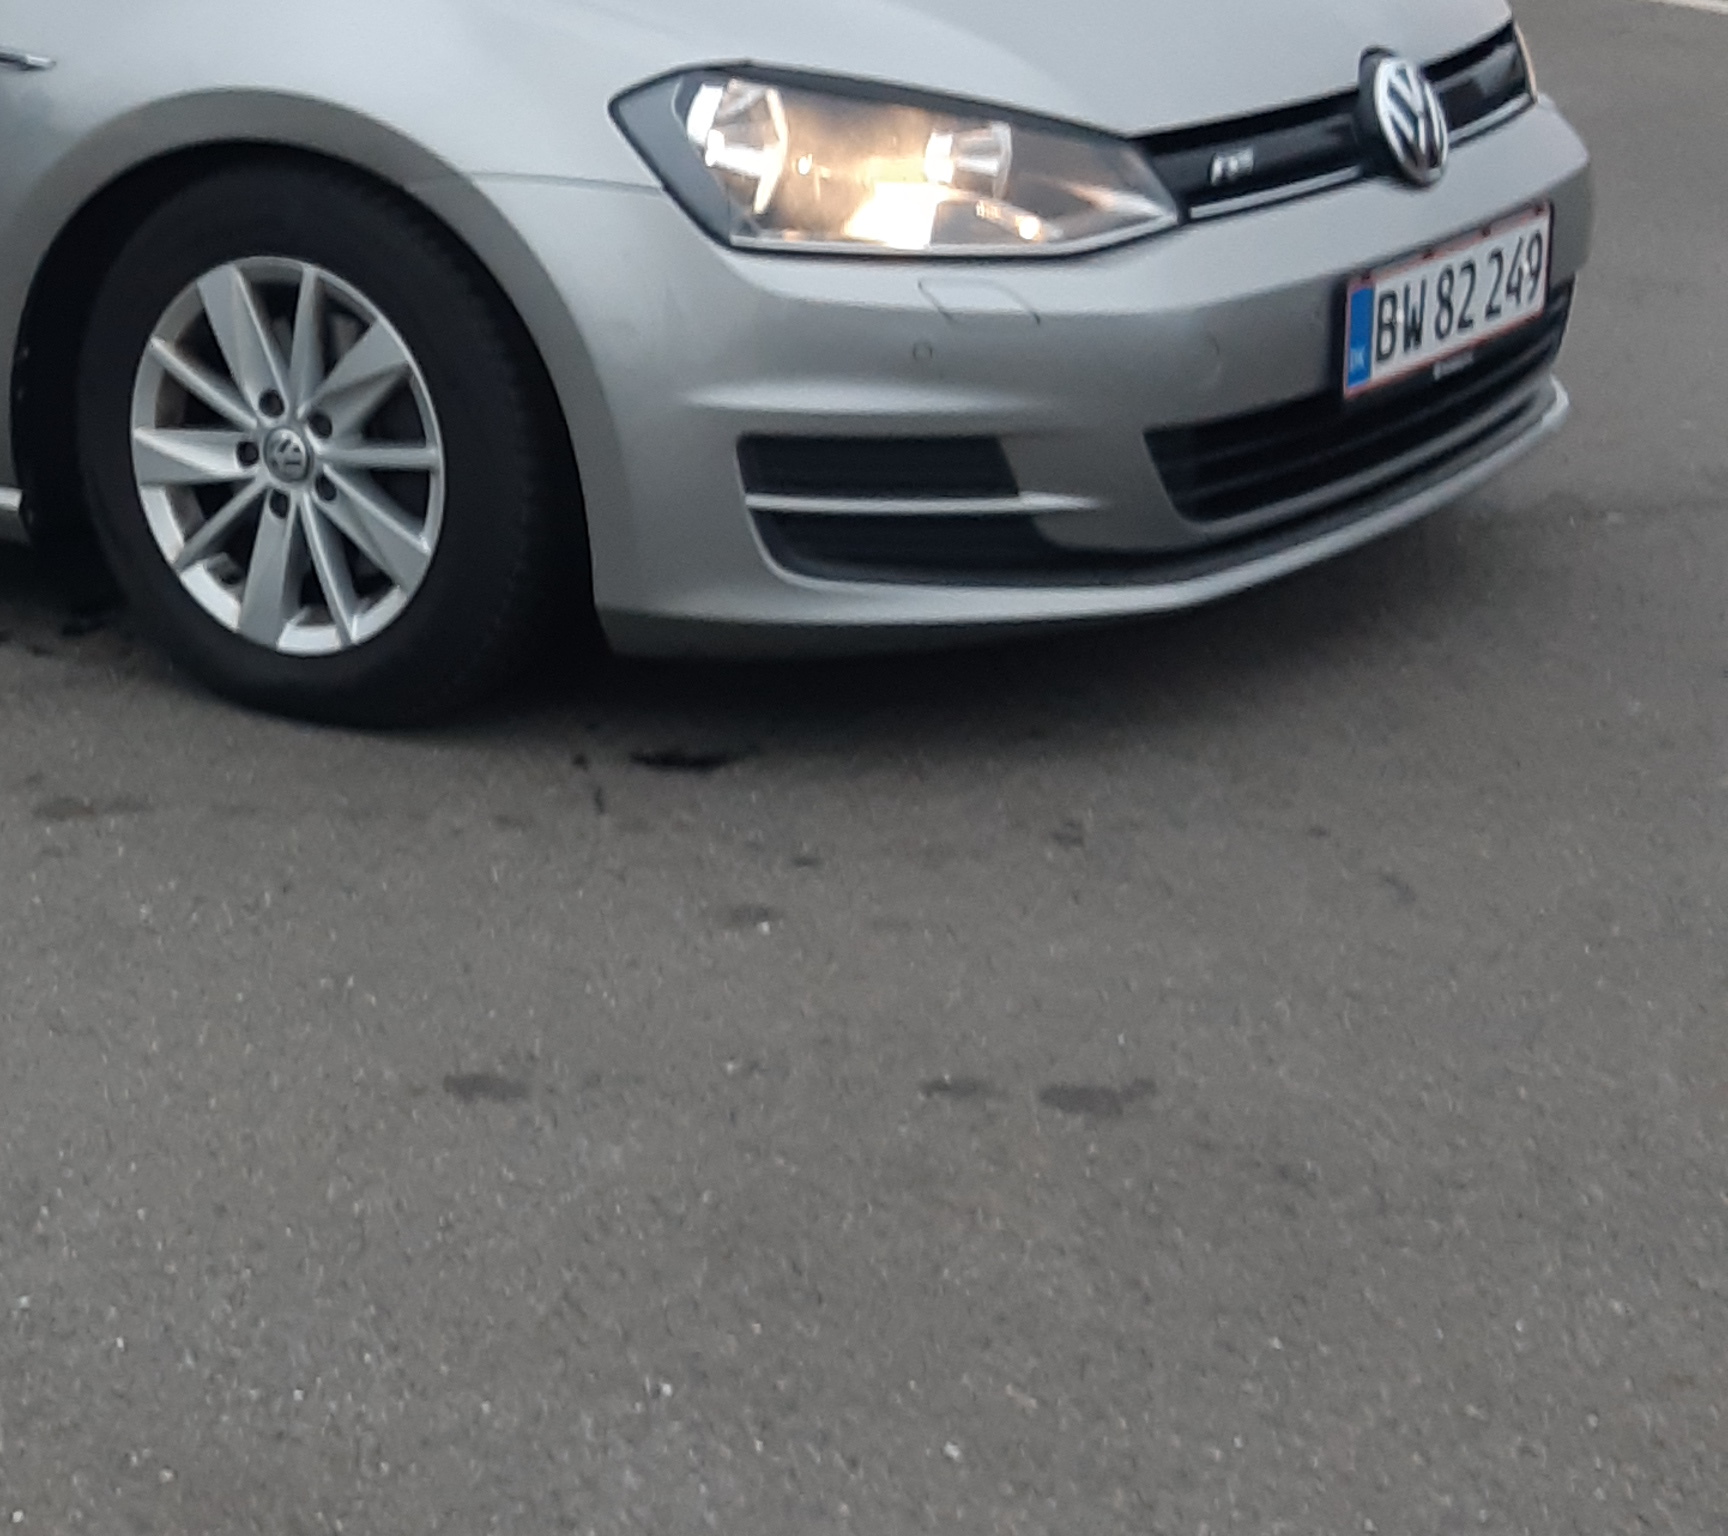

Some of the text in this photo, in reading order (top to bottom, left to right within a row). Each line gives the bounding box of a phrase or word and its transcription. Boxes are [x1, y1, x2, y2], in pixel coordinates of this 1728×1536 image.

[1375, 229, 1543, 362] BW 82 249
